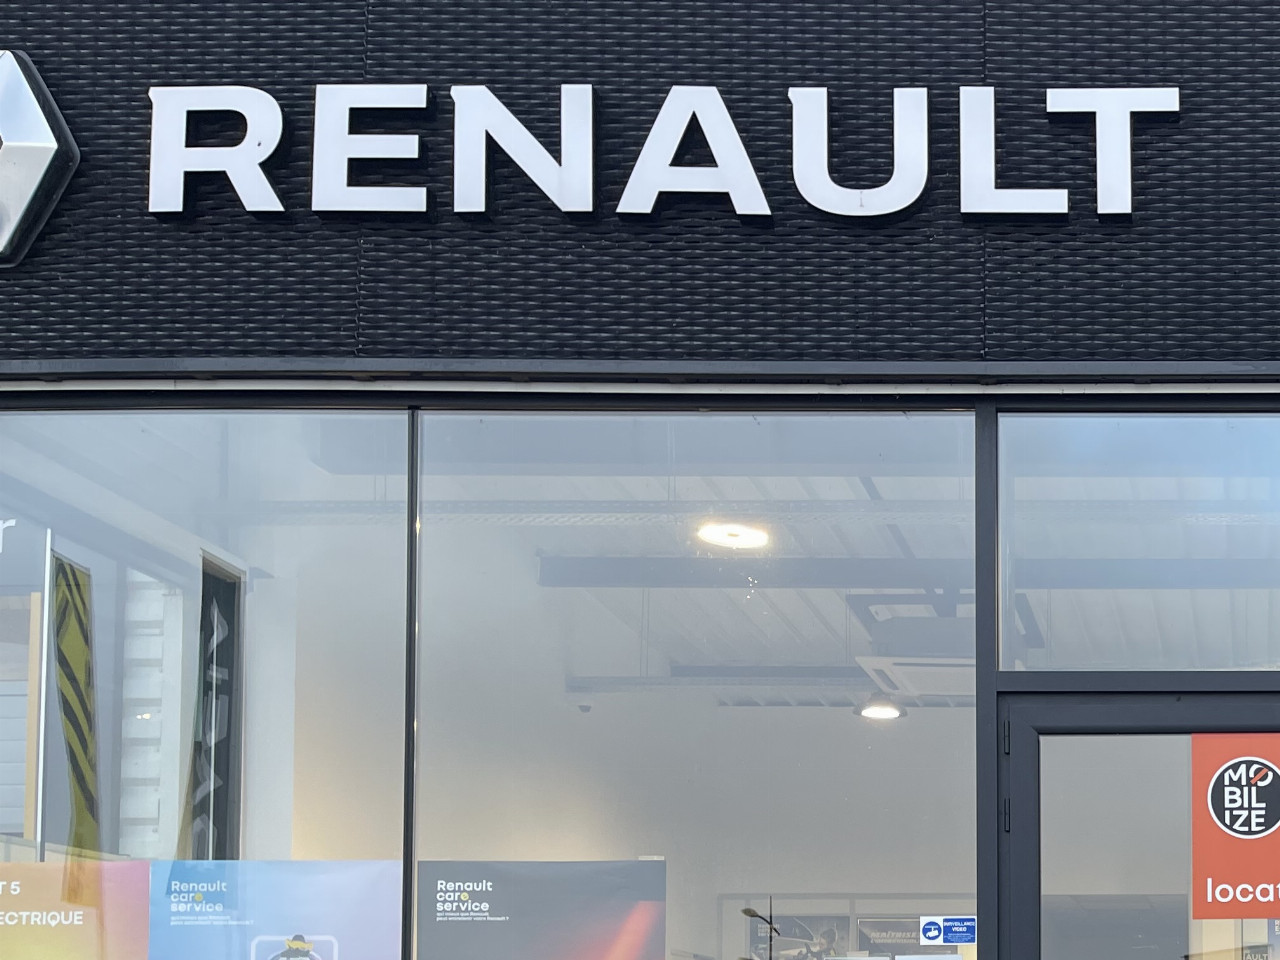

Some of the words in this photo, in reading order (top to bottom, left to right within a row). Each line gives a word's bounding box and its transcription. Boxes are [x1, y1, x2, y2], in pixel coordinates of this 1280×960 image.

[148, 84, 1180, 217] RENAULT
[10, 881, 20, 895] 5
[171, 880, 227, 892] Renault
[437, 879, 493, 891] Renault
[436, 892, 469, 901] care
[170, 900, 223, 912] service
[436, 900, 490, 911] service
